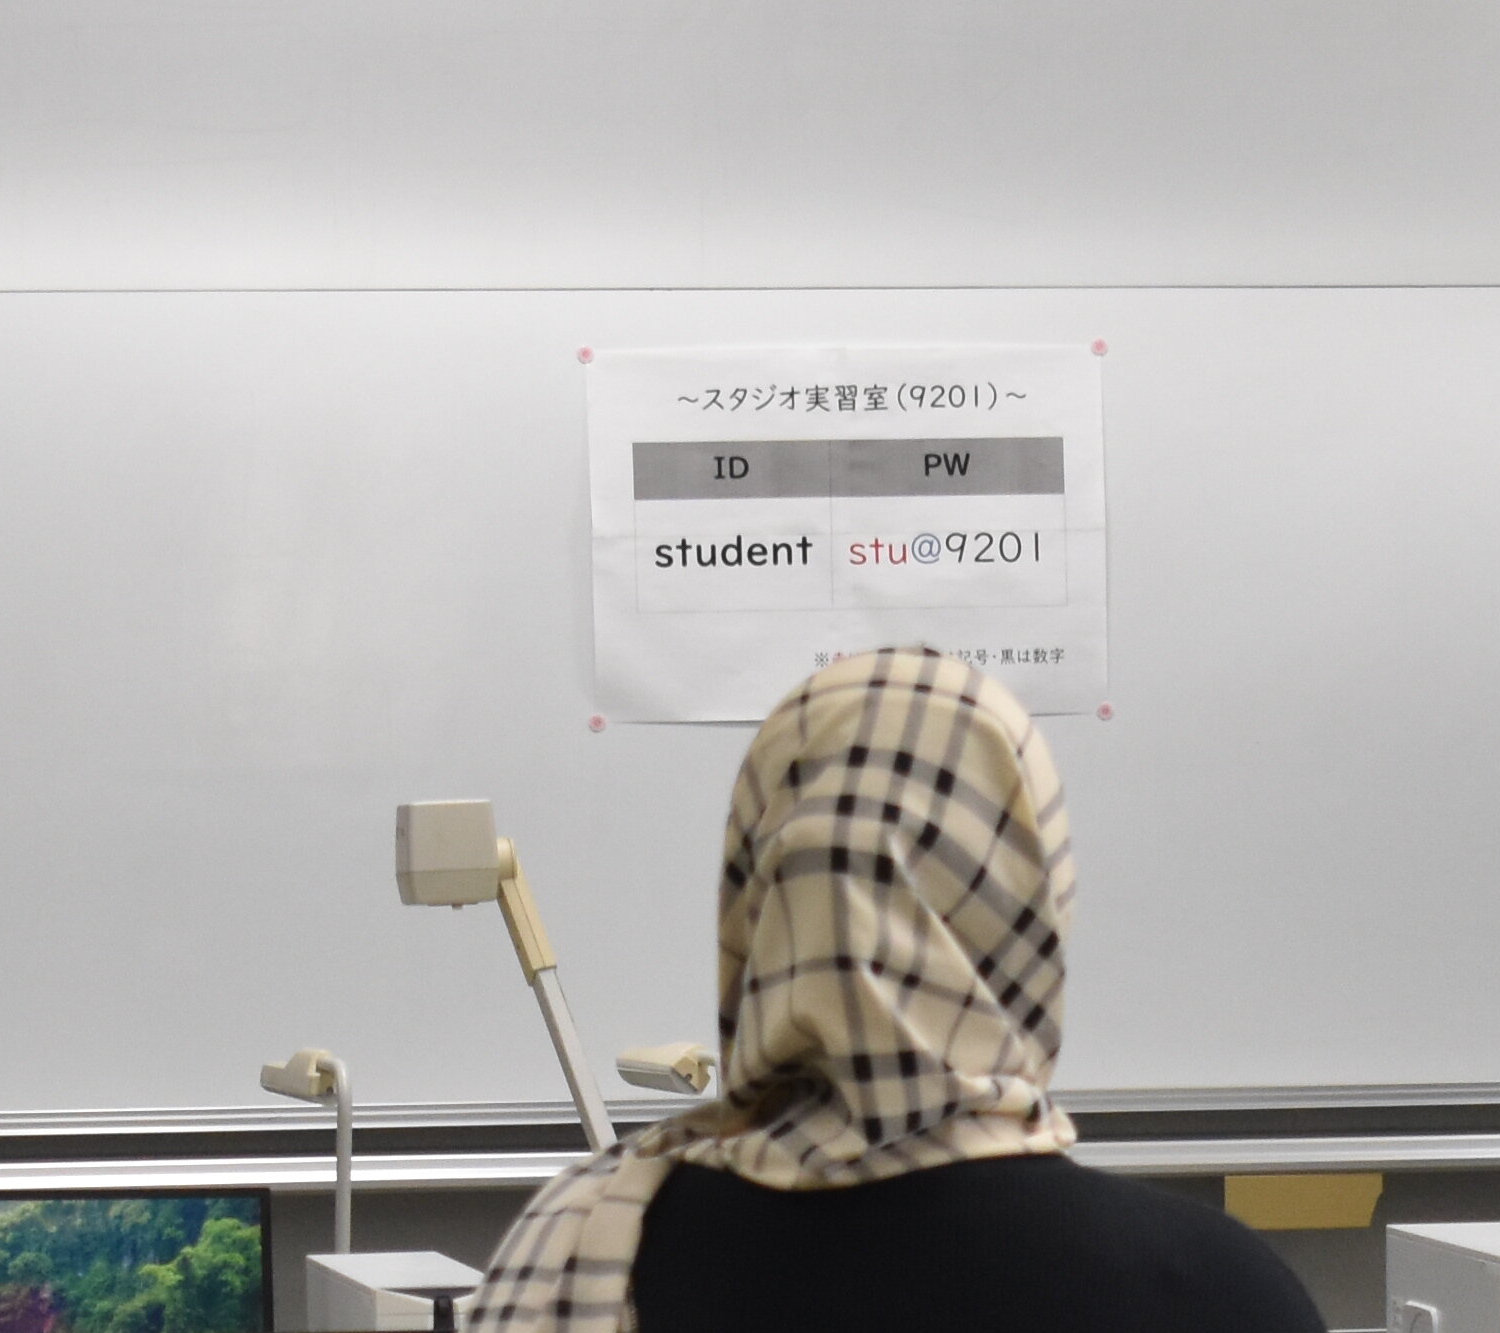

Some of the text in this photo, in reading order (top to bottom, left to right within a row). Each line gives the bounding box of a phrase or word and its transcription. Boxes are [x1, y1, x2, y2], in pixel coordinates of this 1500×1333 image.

[713, 455, 750, 480] ID
[924, 452, 971, 477] PW
[654, 534, 814, 568] student
[849, 531, 1041, 566] stu@9201
